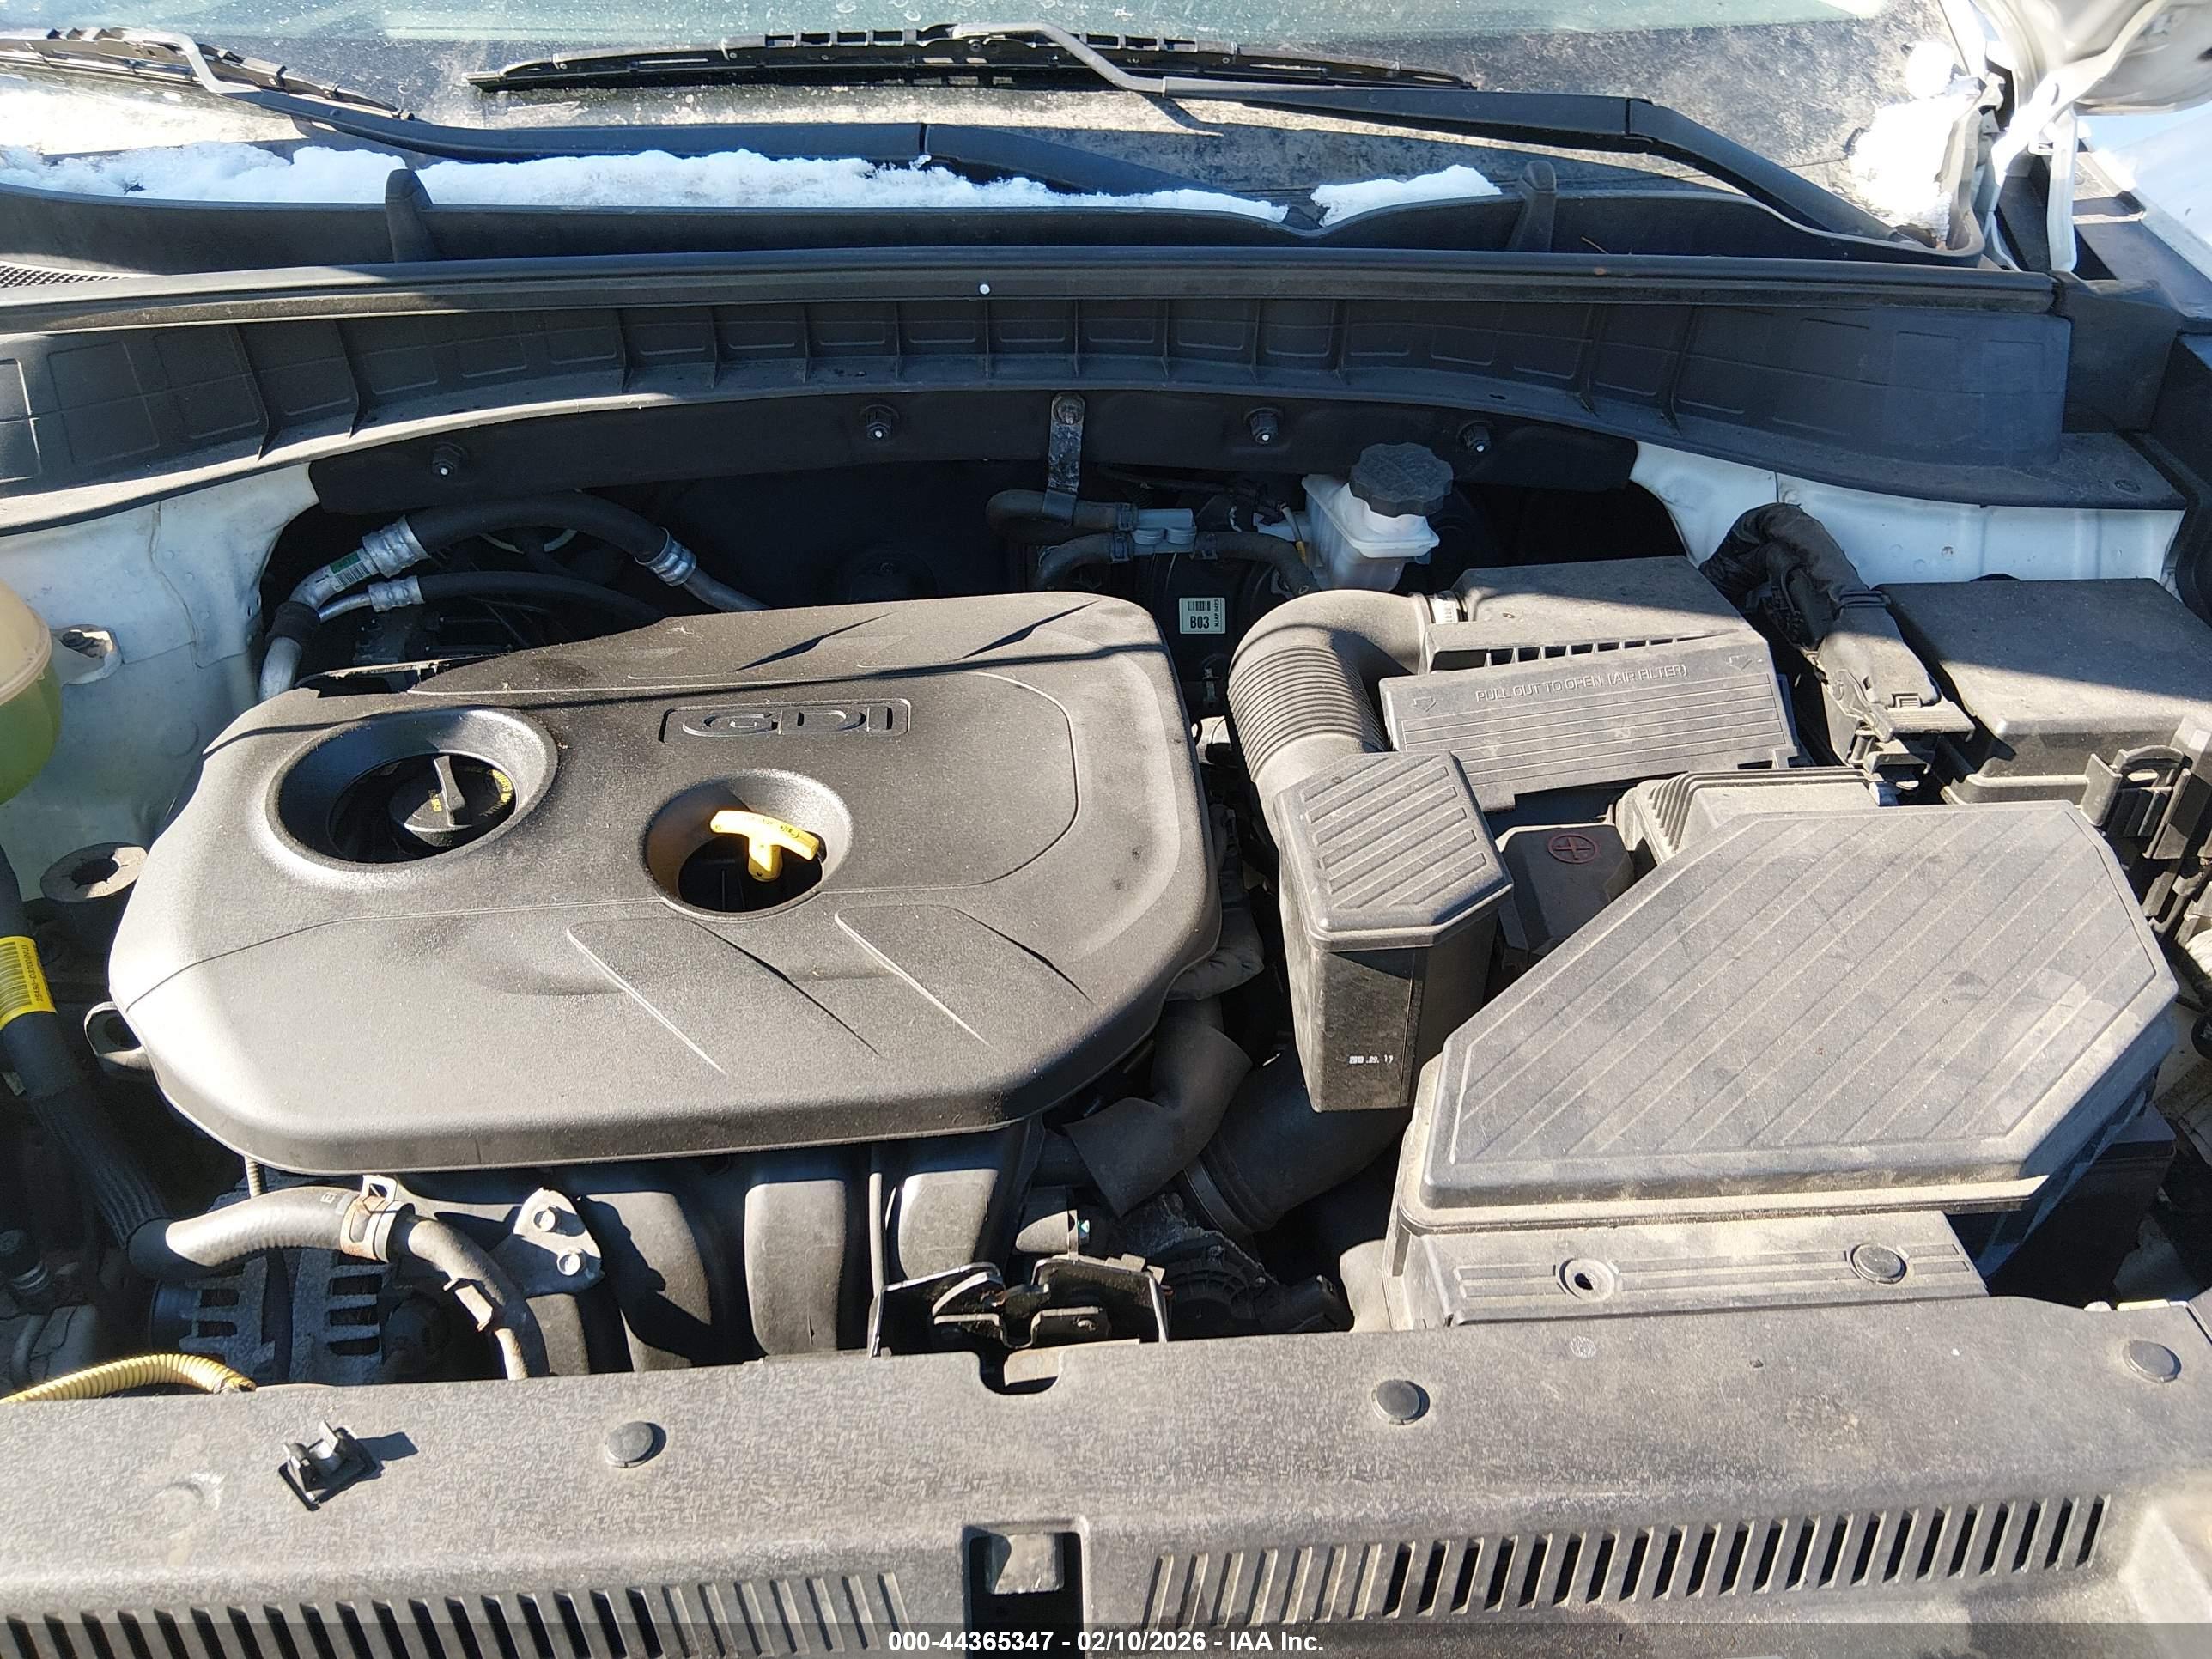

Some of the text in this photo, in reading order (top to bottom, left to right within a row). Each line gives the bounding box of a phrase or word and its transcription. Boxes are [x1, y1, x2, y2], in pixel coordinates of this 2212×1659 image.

[1189, 615, 1209, 629] B03
[1475, 664, 1689, 702] PULL OUT TO OPEN (AIR FILTER)
[682, 706, 893, 737] GDI
